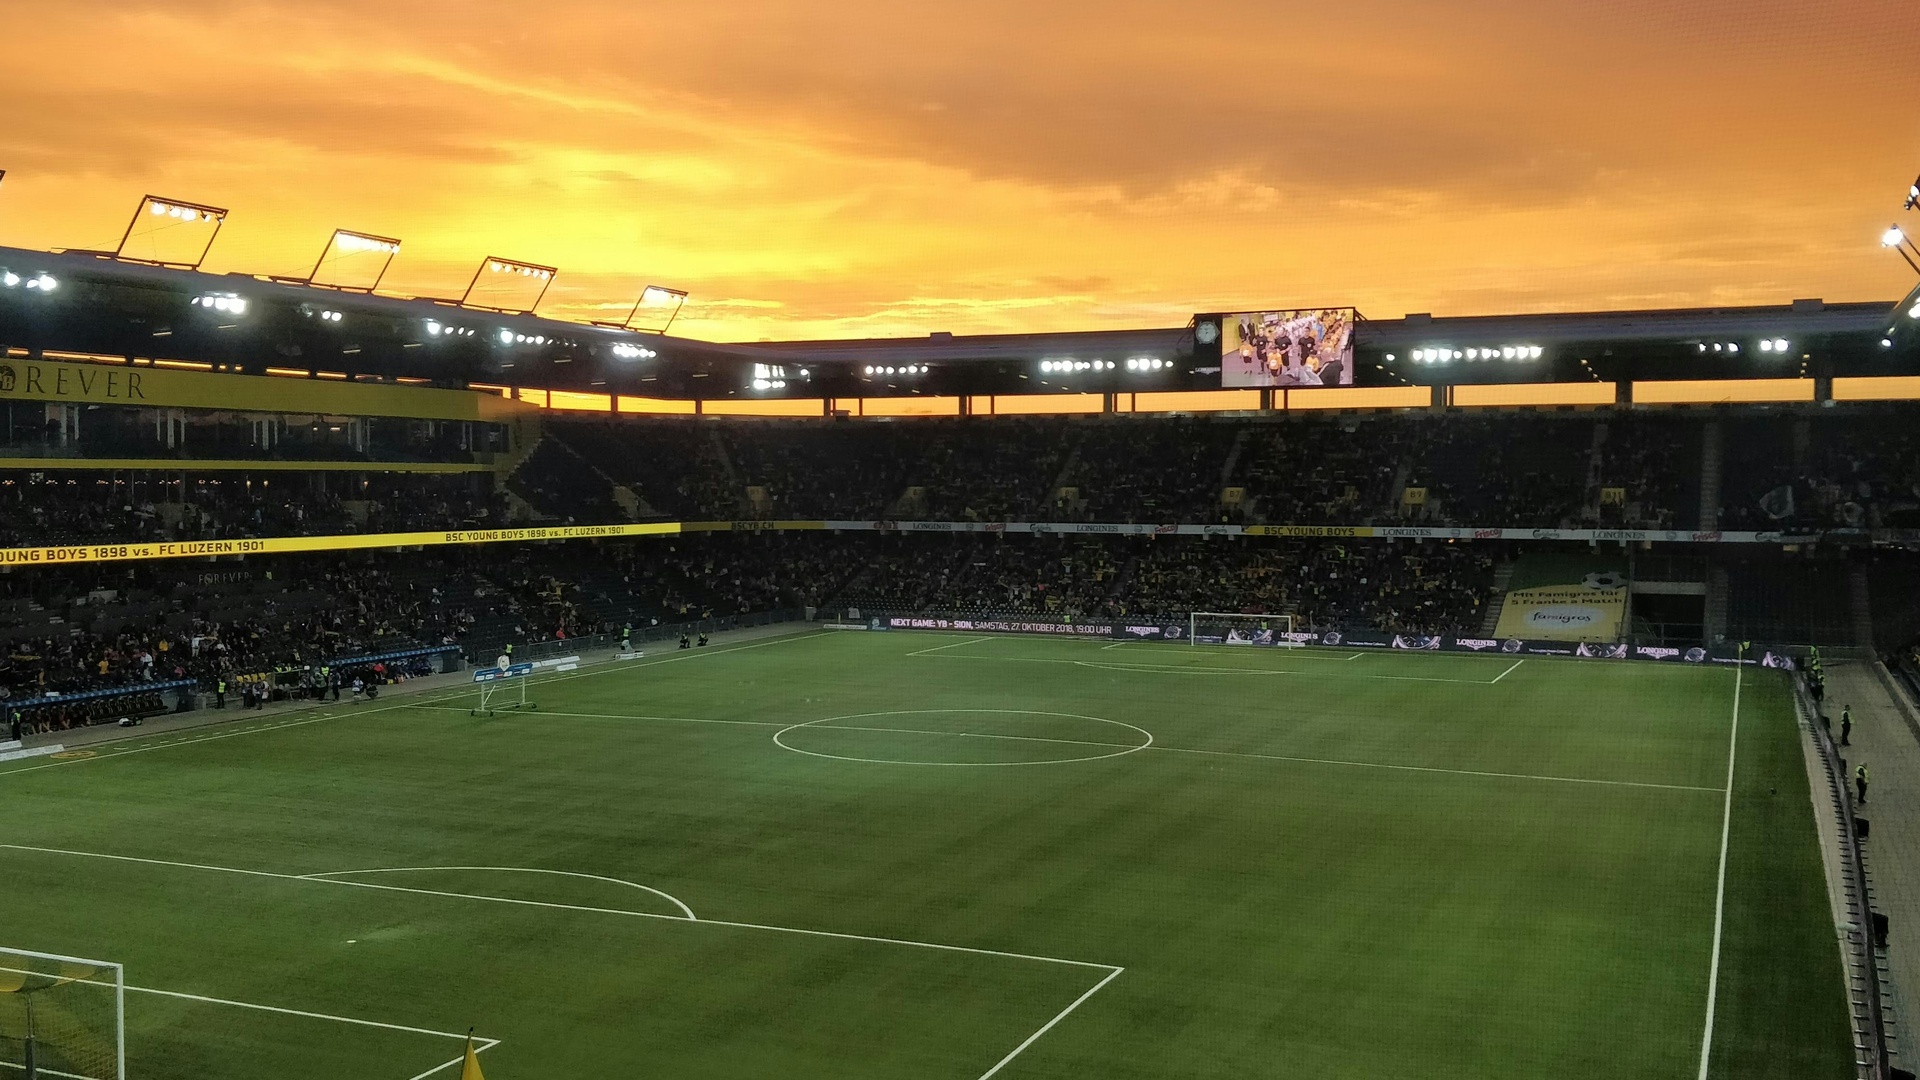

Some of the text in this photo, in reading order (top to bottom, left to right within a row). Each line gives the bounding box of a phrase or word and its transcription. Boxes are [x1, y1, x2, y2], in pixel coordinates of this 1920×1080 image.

[446, 526, 624, 541] BSC YOUNG BOYS 1898 vs. FC LUZERN 1901
[1264, 526, 1355, 536] BSC YOUNG BOYS
[1475, 529, 1499, 539] Frisco
[1592, 531, 1646, 539] LONGINES
[47, 548, 87, 560] BOYS
[93, 547, 127, 558] 1898
[133, 548, 153, 557] vs.
[160, 545, 175, 555] FC
[181, 542, 232, 554] LUZERN
[237, 541, 264, 551] 1901
[1513, 591, 1535, 599] Mit
[1539, 590, 1597, 599] Famigros
[1533, 611, 1592, 623] famigros
[891, 618, 911, 627] NEXT
[912, 619, 935, 628] GAME:
[936, 620, 947, 628] YB
[954, 620, 974, 630] SION,
[975, 621, 1010, 631] SAMSTAG,
[1022, 623, 1055, 632] OKTOBER
[1056, 624, 1075, 634] 2018,
[1076, 625, 1095, 633] 19:00
[1095, 625, 1112, 634] UHR
[1125, 626, 1159, 634] LONGINES
[1456, 638, 1498, 647] LONGINES
[1637, 646, 1680, 656] LONGINES
